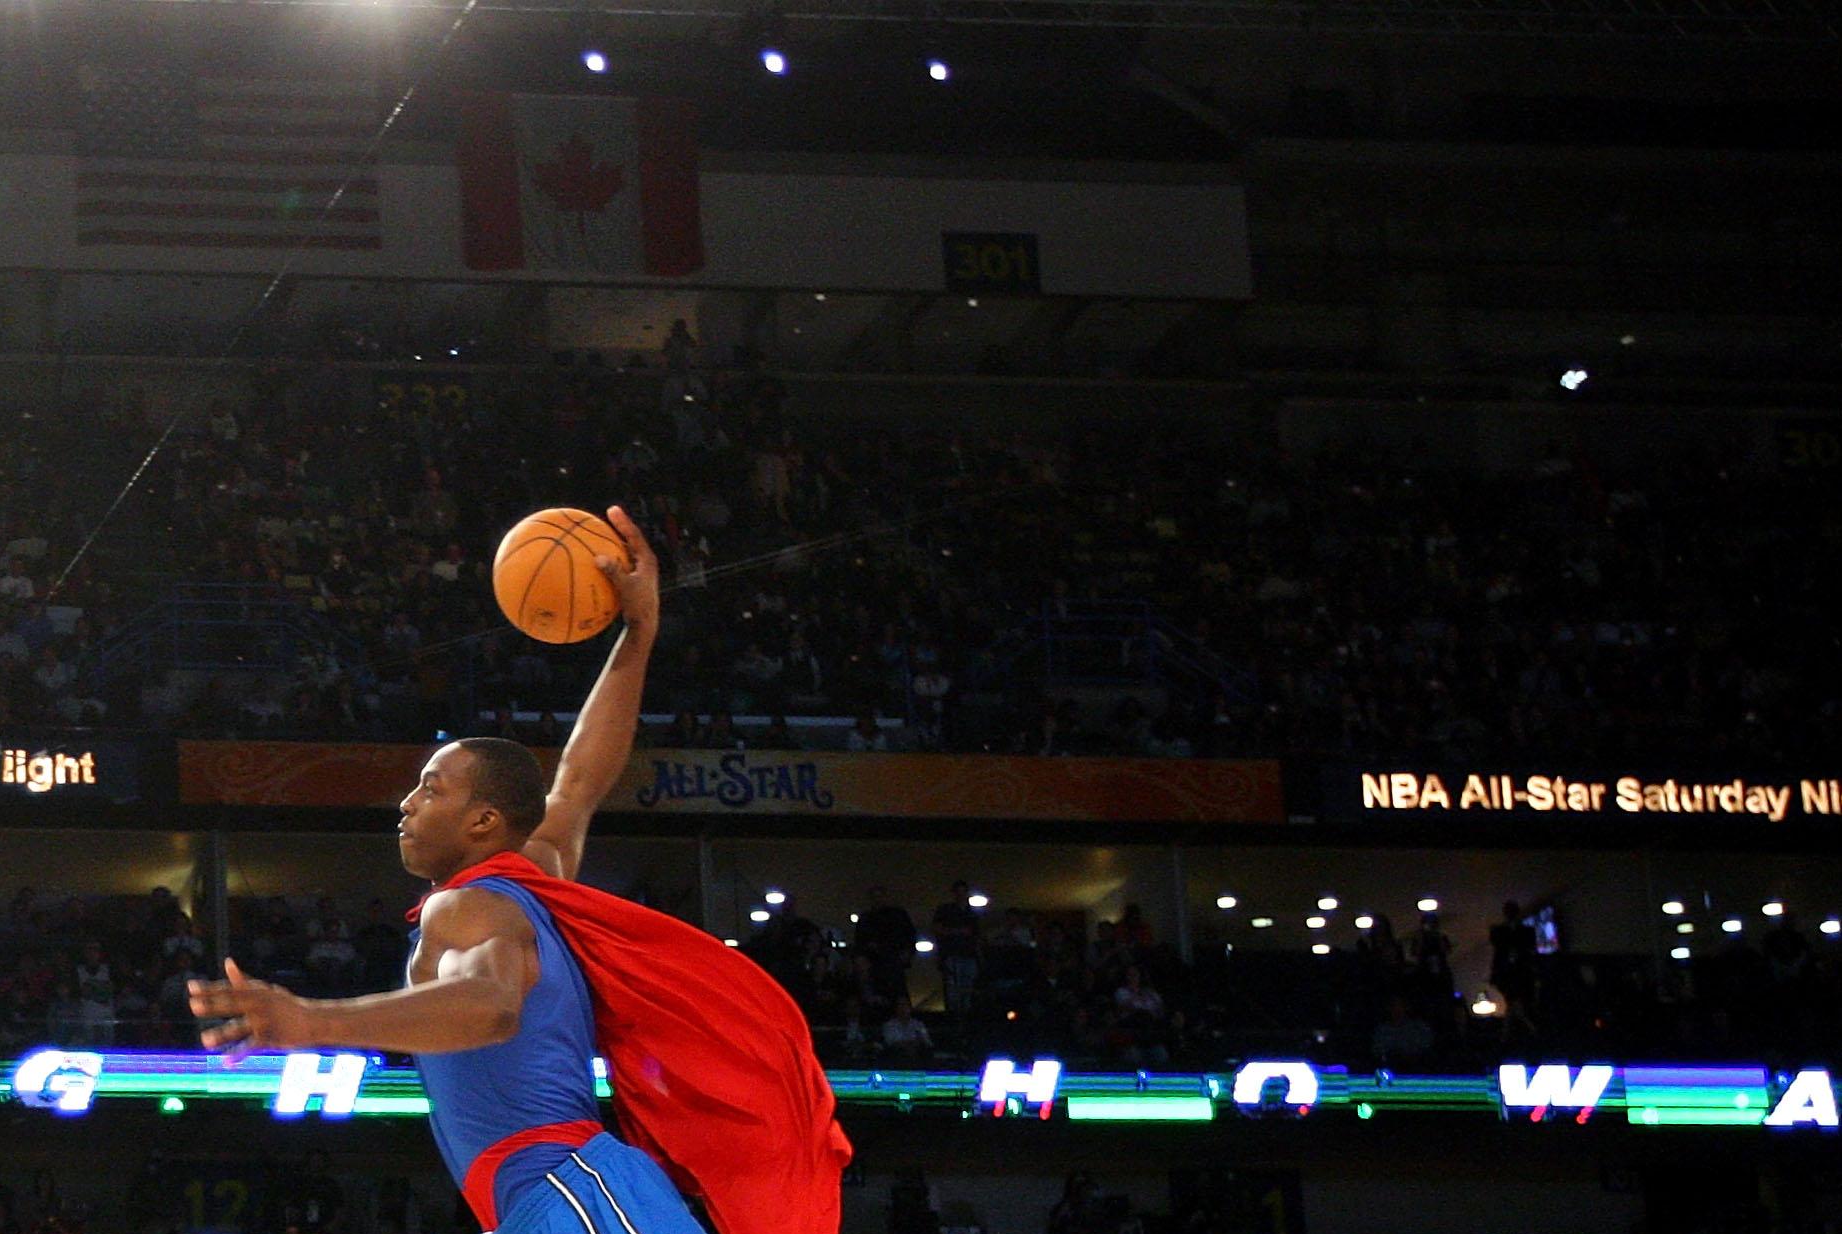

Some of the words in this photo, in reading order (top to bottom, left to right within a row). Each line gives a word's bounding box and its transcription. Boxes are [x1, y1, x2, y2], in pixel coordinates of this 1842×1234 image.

[954, 243, 1032, 280] 301
[1361, 772, 1451, 810] NBA
[1459, 774, 1607, 811] All-Star
[1616, 777, 1789, 822] Saturday
[1801, 779, 1842, 815] Ni
